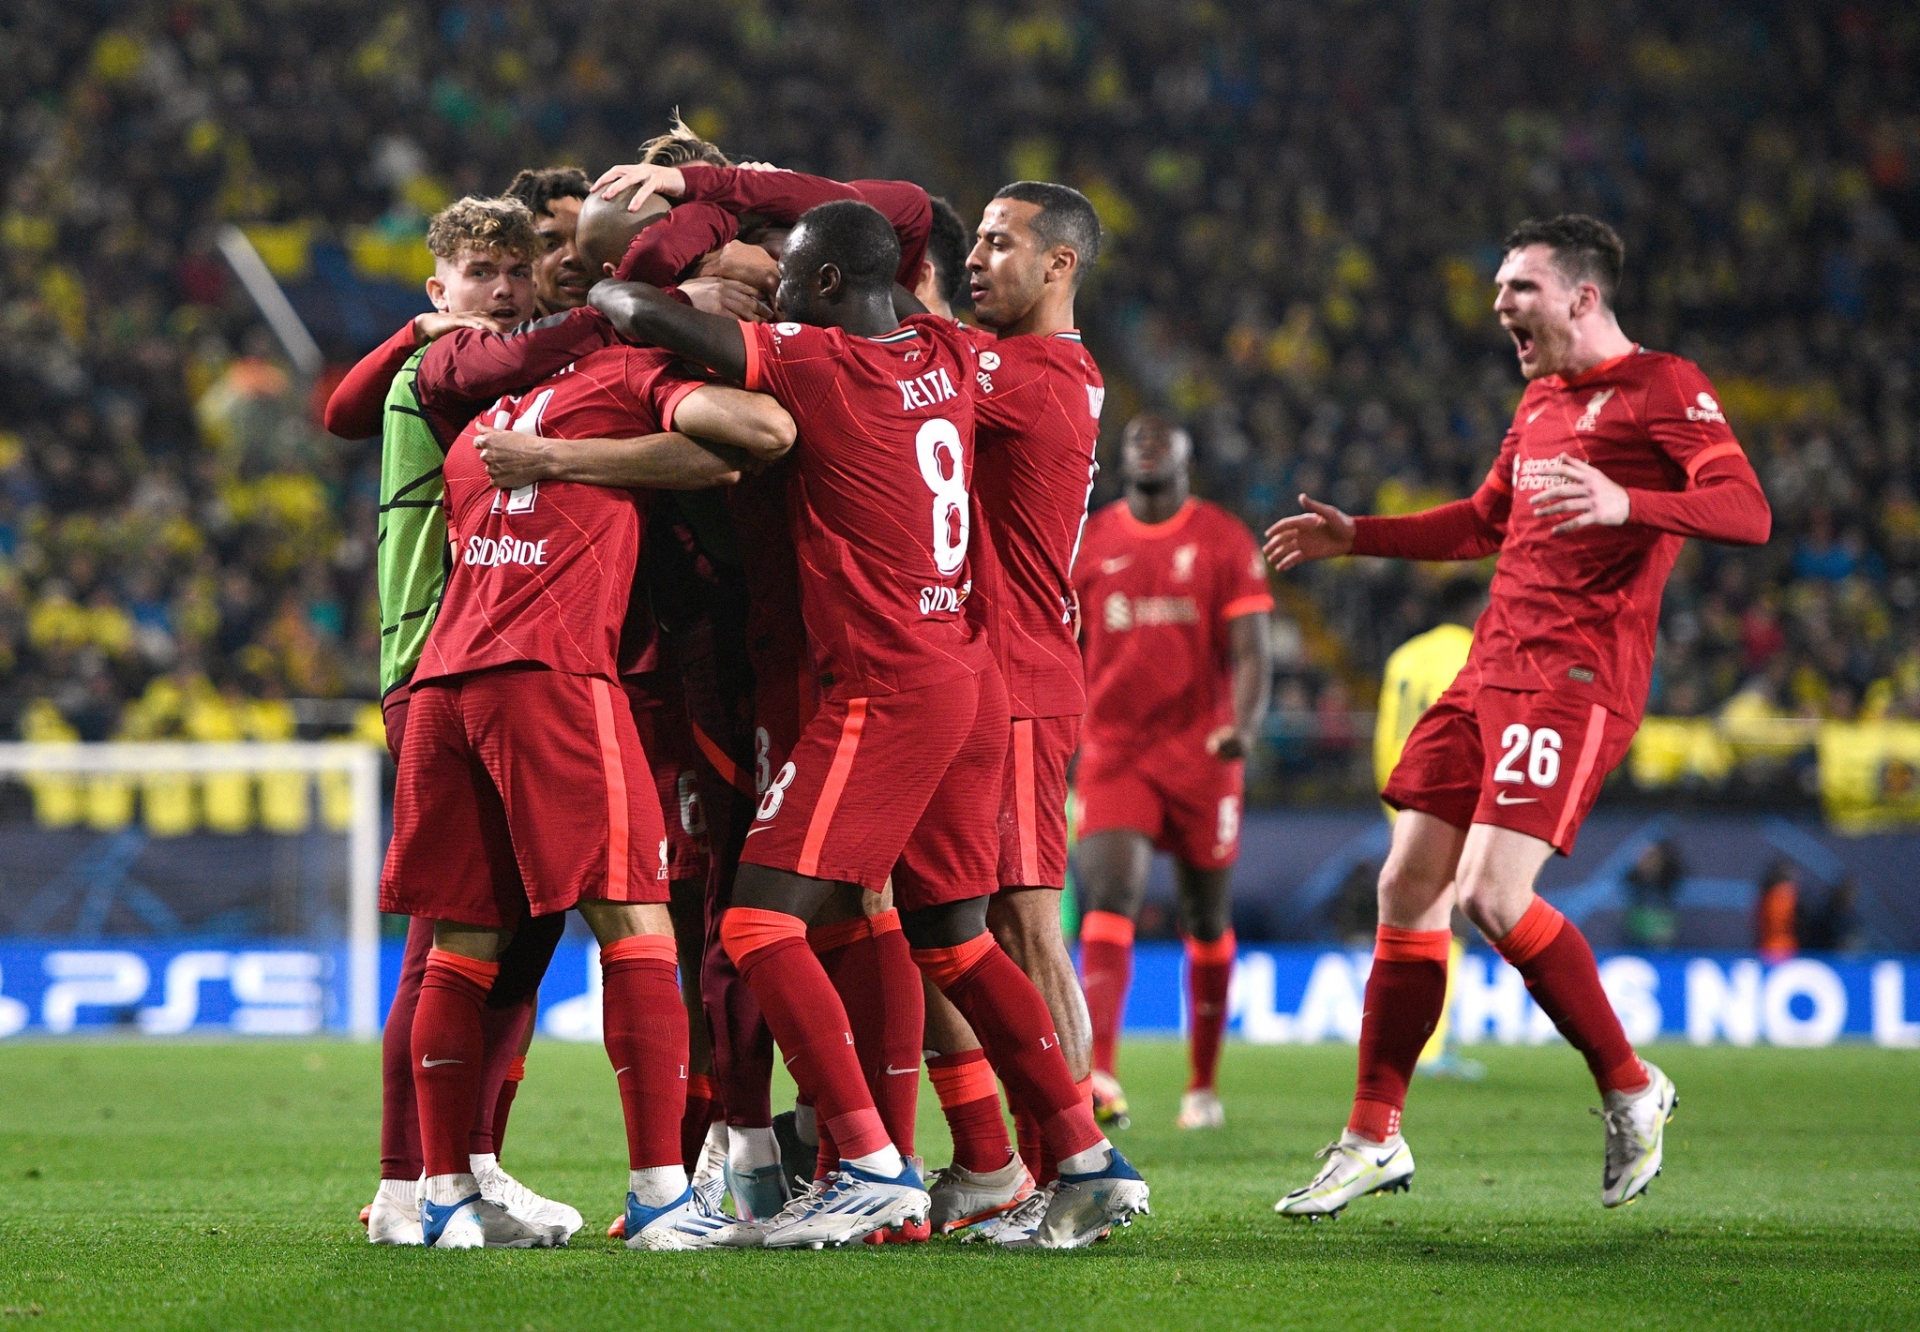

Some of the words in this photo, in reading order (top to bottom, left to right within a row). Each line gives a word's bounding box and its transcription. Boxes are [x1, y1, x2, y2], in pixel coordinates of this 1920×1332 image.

[897, 367, 958, 411] KEITA
[915, 418, 969, 576] 8
[1493, 723, 1563, 788] 26
[756, 761, 797, 822] 8
[1684, 957, 1848, 1049] NO
